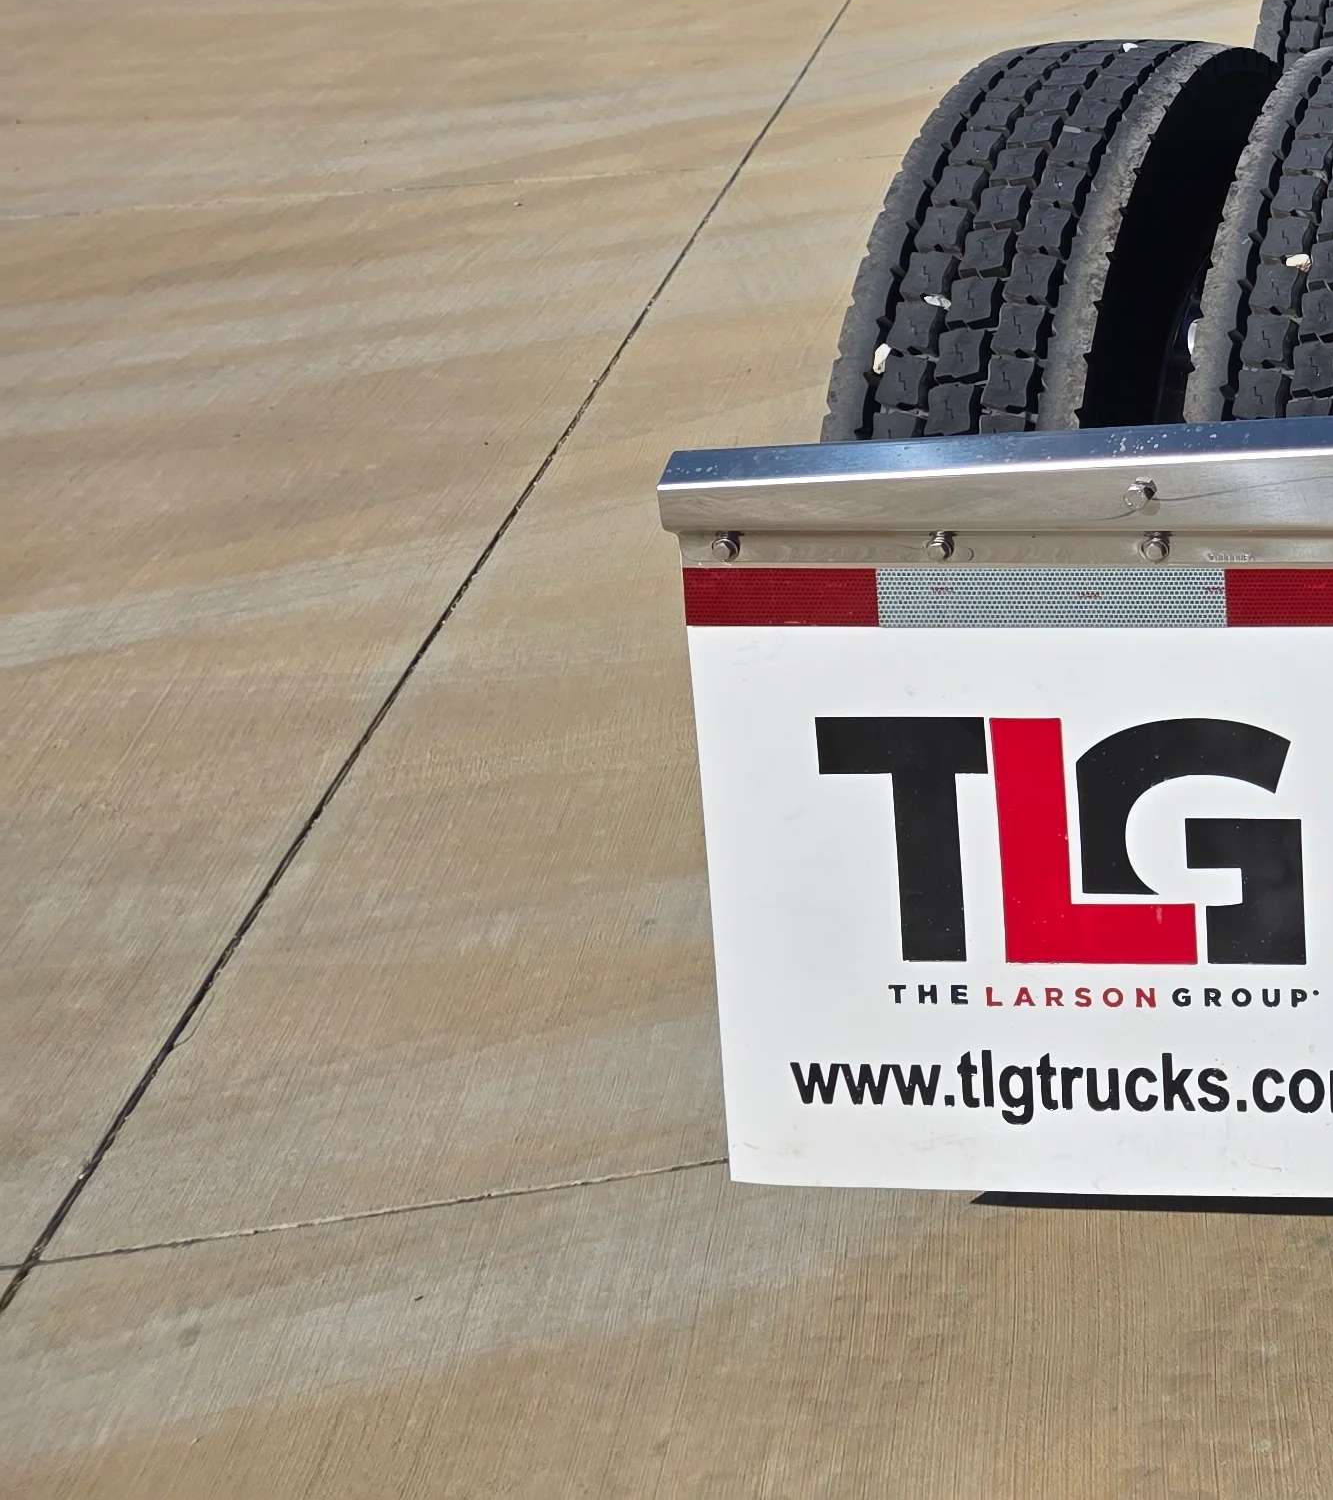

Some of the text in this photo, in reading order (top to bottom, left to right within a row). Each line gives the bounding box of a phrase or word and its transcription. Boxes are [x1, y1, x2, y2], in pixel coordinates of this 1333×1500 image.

[814, 716, 1307, 966] TLG
[887, 984, 969, 1005] THE
[985, 986, 1157, 1008] LARSON
